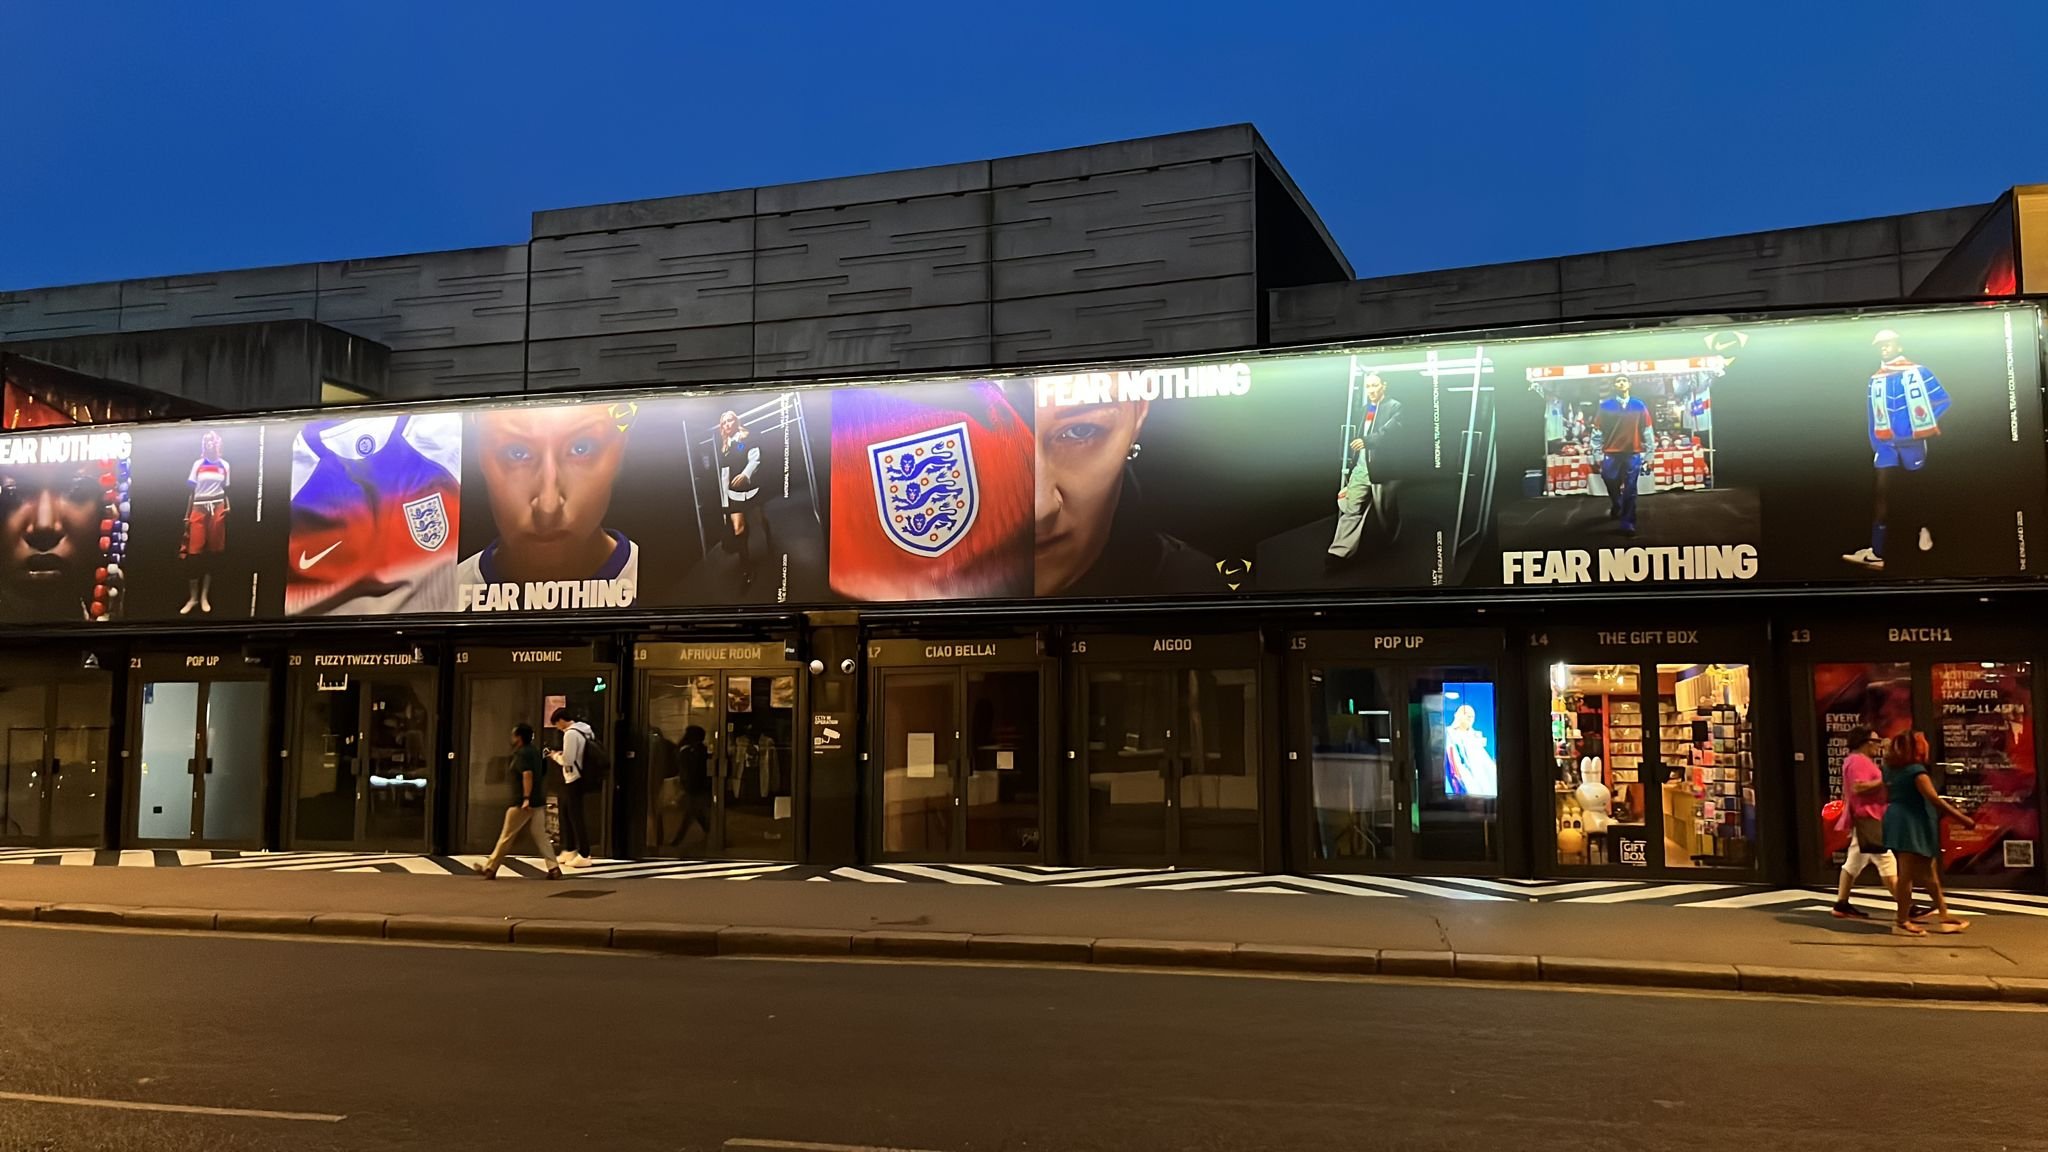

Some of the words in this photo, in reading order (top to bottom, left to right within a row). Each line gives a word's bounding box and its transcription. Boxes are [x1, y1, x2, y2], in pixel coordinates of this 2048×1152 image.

[1038, 372, 1114, 408] FEAR
[1118, 363, 1251, 402] NOTHING
[2008, 391, 2016, 410] TEAM
[2010, 410, 2018, 442] NATIONAL
[0, 437, 39, 465] EAR
[40, 432, 132, 463] NOTHING
[1503, 549, 1592, 585] FEAR
[1598, 544, 1758, 582] NOTHING
[459, 582, 521, 612] FEAR
[524, 580, 634, 610] NOTHING
[1530, 633, 1549, 646] 14
[1597, 632, 1628, 645] THE
[1630, 631, 1664, 644] GIFT
[1666, 631, 1698, 644] BOX
[1791, 629, 1810, 642] 13
[1889, 628, 1952, 642] BATCH1
[1072, 641, 1087, 653] 16
[1153, 639, 1192, 651] AIGOO
[1290, 637, 1307, 649] 15
[1374, 636, 1402, 649] POP
[1404, 635, 1424, 649] UP
[511, 651, 562, 662] YYATOMIC
[634, 649, 647, 660] 18
[680, 648, 727, 660] AFRIQUE
[728, 647, 761, 660] ROOM
[868, 646, 881, 658] 17
[925, 646, 952, 658] CIAO
[954, 644, 996, 657] BELLA!
[130, 658, 142, 668] 21
[186, 656, 205, 666] POP
[206, 656, 220, 666] UP
[289, 655, 302, 666] 20
[315, 655, 345, 666] FUZZY
[345, 654, 382, 665] TWIZZY
[383, 654, 411, 665] STUDI
[456, 652, 469, 663] 19
[1941, 689, 1999, 700] TAKEOVER
[1825, 713, 1860, 722] EVERY
[1624, 843, 1645, 852] GIFT
[1624, 852, 1645, 861] BOX
